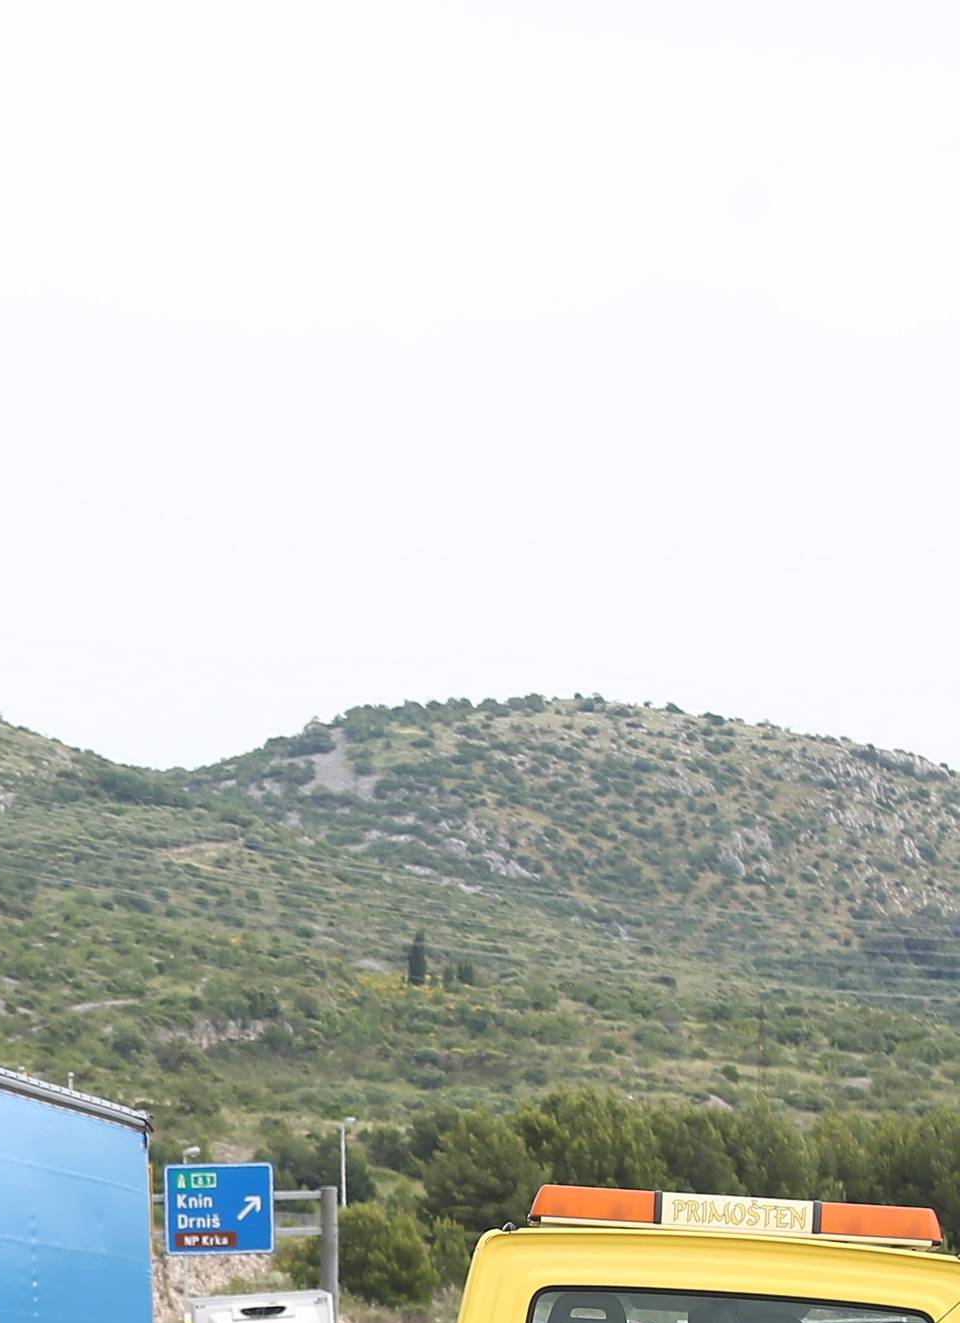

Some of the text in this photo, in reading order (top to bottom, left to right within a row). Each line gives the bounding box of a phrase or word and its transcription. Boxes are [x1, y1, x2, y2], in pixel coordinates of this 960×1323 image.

[177, 1194, 213, 1209] Knin
[177, 1213, 221, 1229] Drniš
[672, 1199, 807, 1230] PRIMOŠTEN
[183, 1234, 230, 1246] NP Krka
